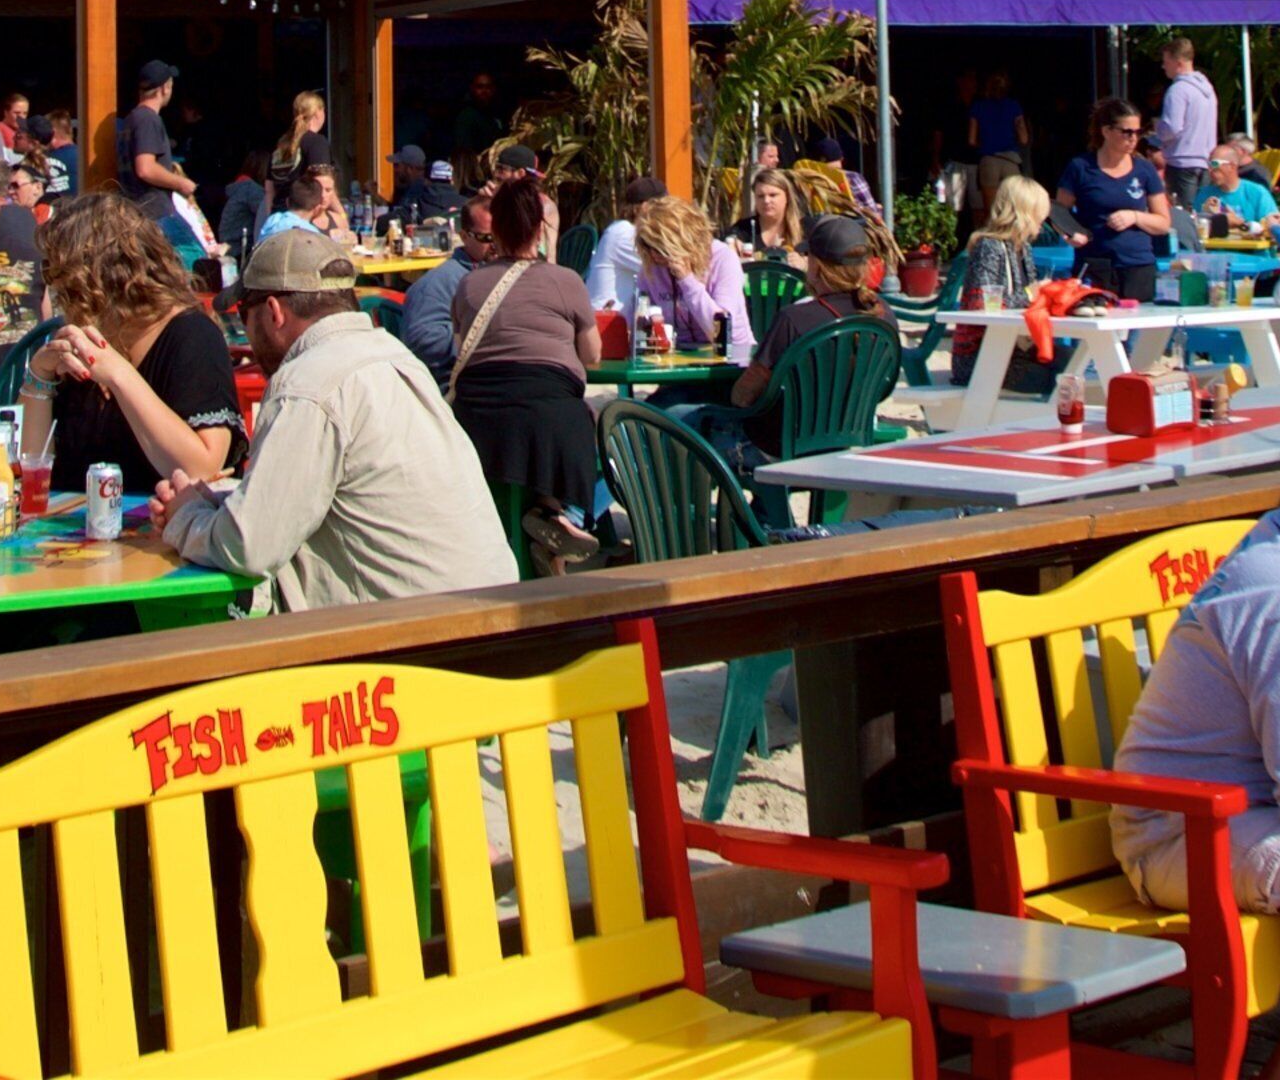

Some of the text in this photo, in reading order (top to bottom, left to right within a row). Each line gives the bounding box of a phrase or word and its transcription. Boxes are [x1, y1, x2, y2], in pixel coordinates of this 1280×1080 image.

[1149, 549, 1211, 607] FISH
[129, 676, 400, 796] FISH TALES
